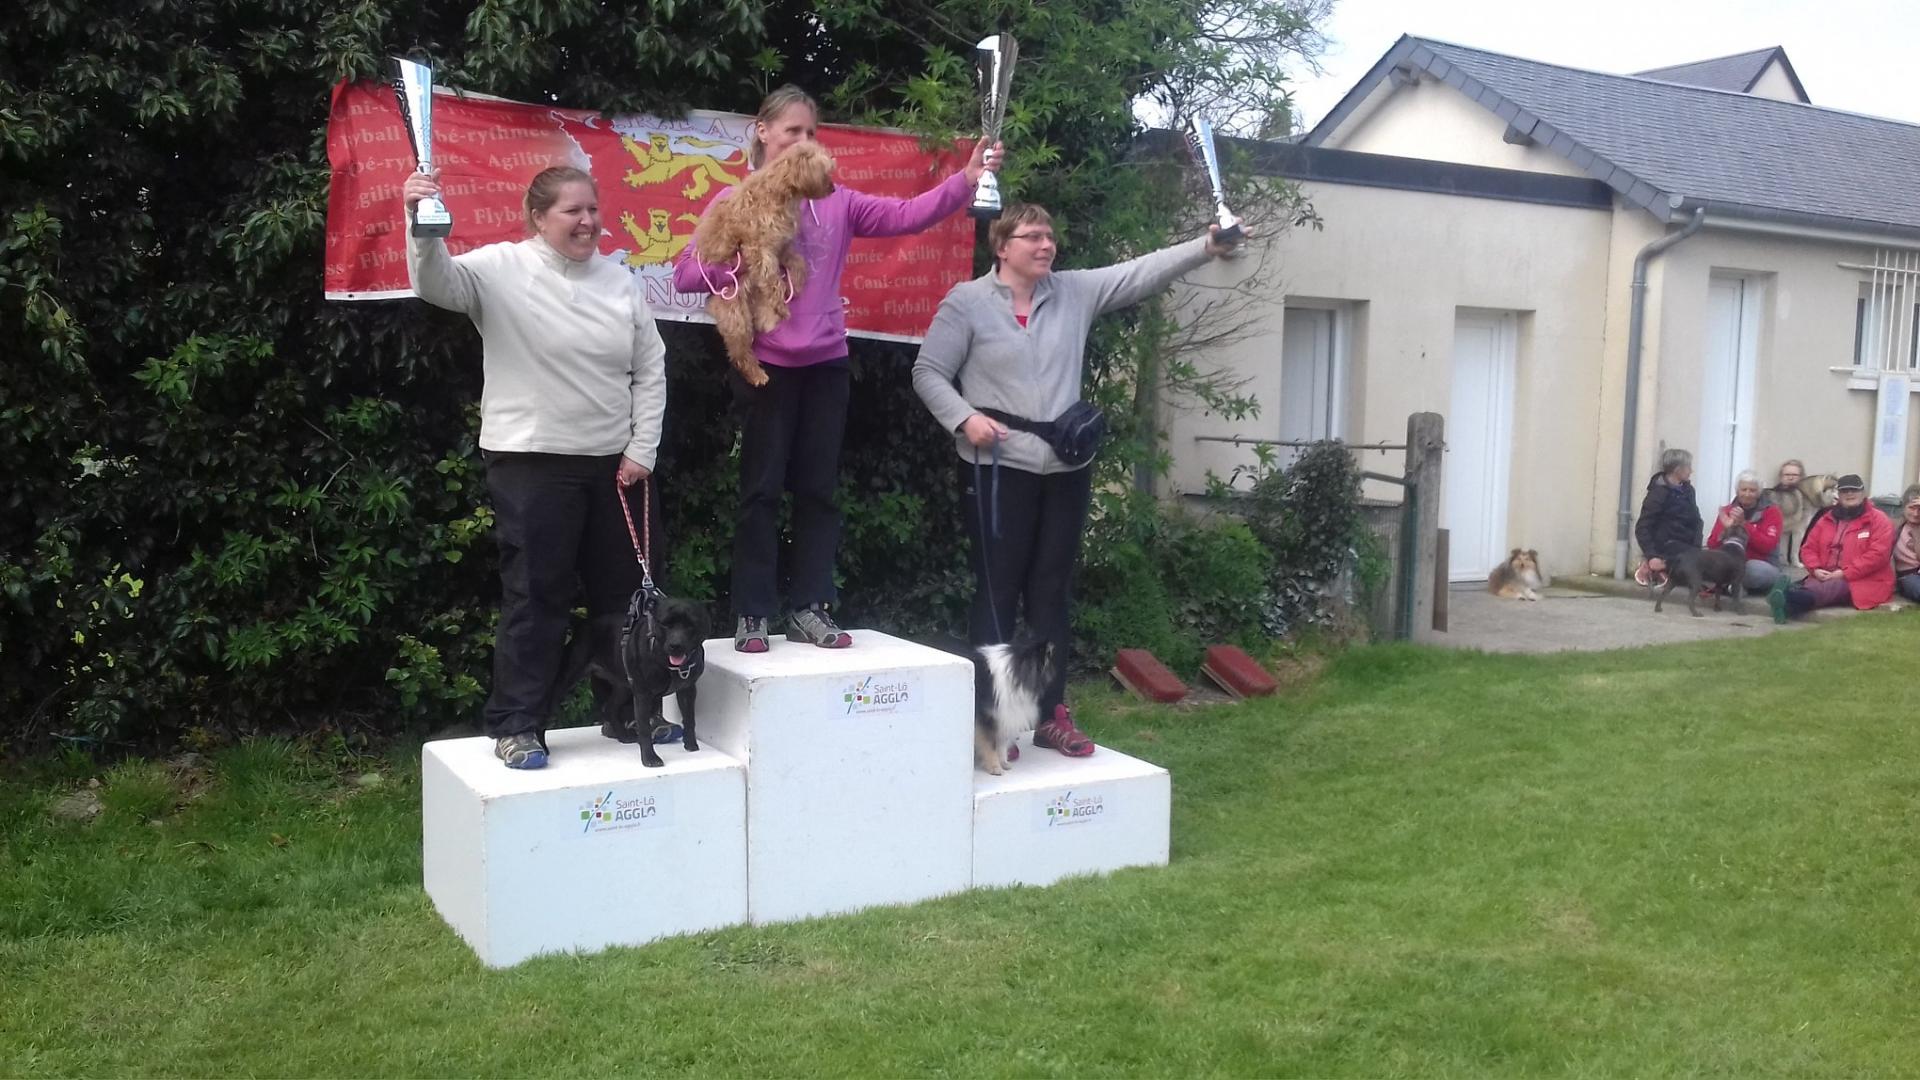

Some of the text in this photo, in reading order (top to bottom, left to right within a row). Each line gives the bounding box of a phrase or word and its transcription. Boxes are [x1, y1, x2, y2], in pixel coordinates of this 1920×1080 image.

[488, 151, 553, 171] Agility
[838, 165, 917, 182] Cani-cross
[897, 245, 944, 266] Agility
[852, 274, 929, 290] Cani-cross
[883, 298, 931, 318] Flyball
[615, 796, 655, 810] Saint-Lô
[615, 806, 656, 822] AGGLO
